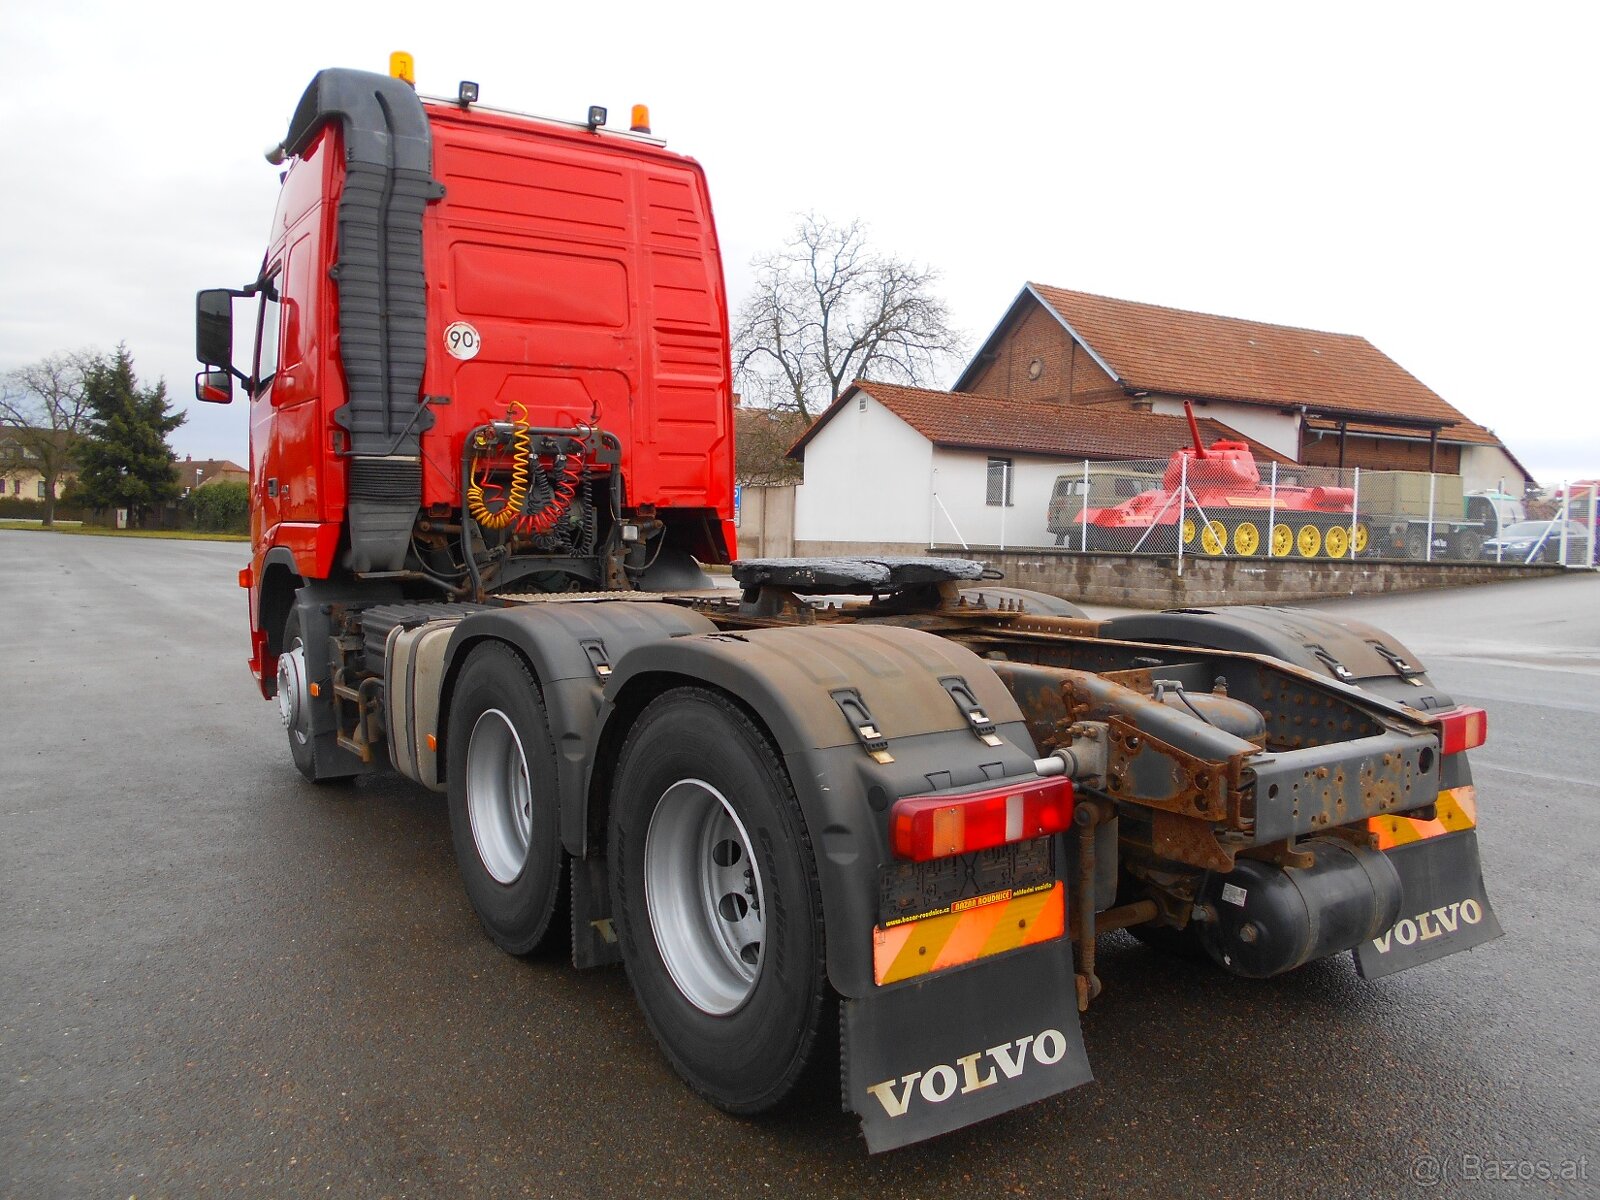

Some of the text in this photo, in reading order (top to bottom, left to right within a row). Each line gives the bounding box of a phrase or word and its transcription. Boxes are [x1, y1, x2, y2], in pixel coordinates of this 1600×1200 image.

[450, 331, 473, 349] 90
[955, 899, 977, 911] BAZAR
[866, 1029, 1067, 1118] VOLVO
